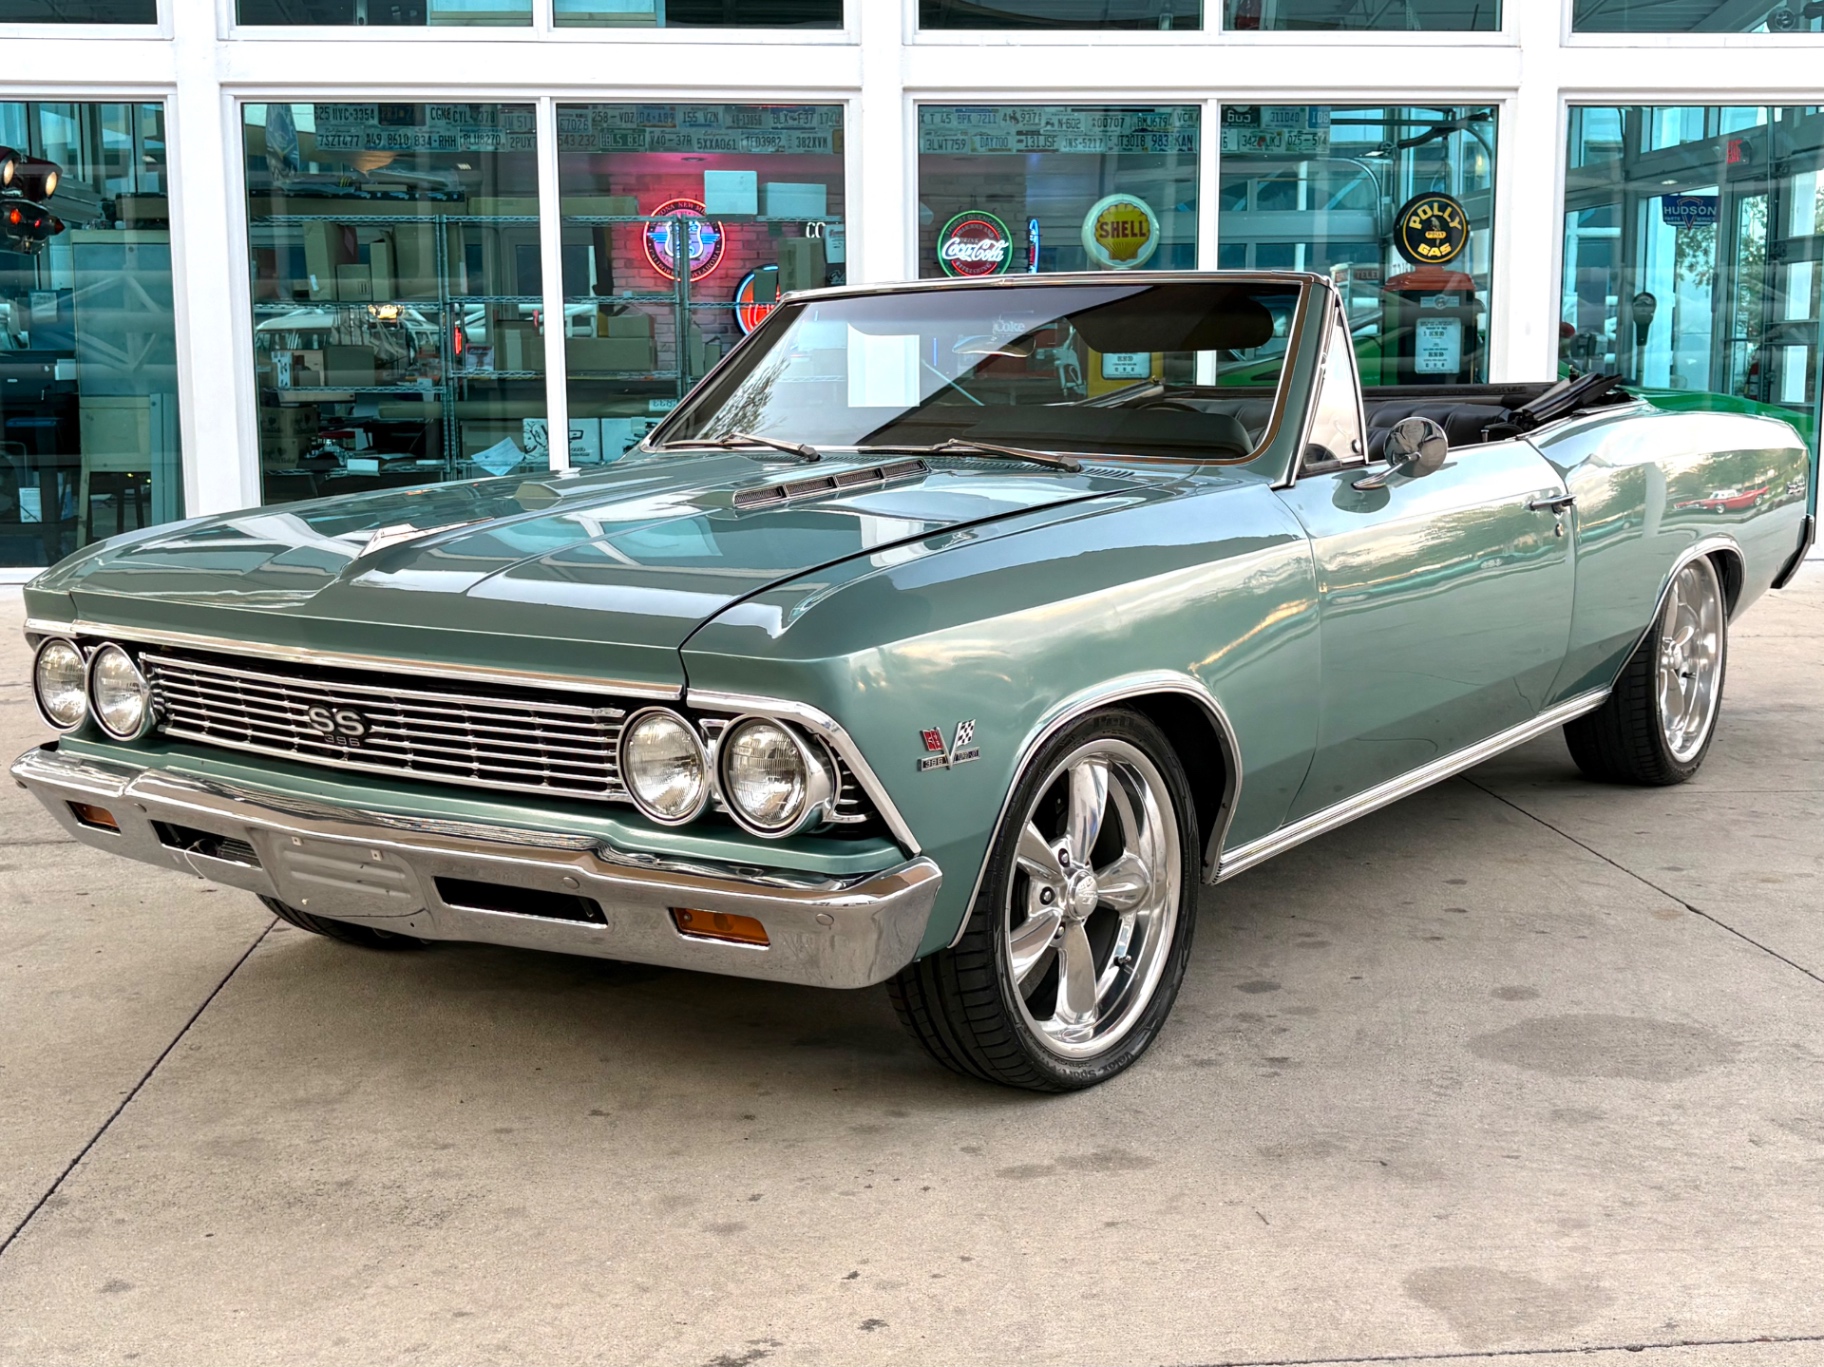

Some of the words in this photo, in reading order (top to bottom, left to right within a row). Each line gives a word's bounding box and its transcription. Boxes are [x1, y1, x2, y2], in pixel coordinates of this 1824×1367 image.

[1408, 202, 1463, 231] POLLY
[1663, 205, 1718, 216] HUDSON
[1098, 219, 1148, 240] SHELL
[942, 237, 1010, 262] Coca-Cola
[1417, 242, 1452, 257] GAS
[307, 706, 366, 737] SS
[323, 733, 361, 748] 396
